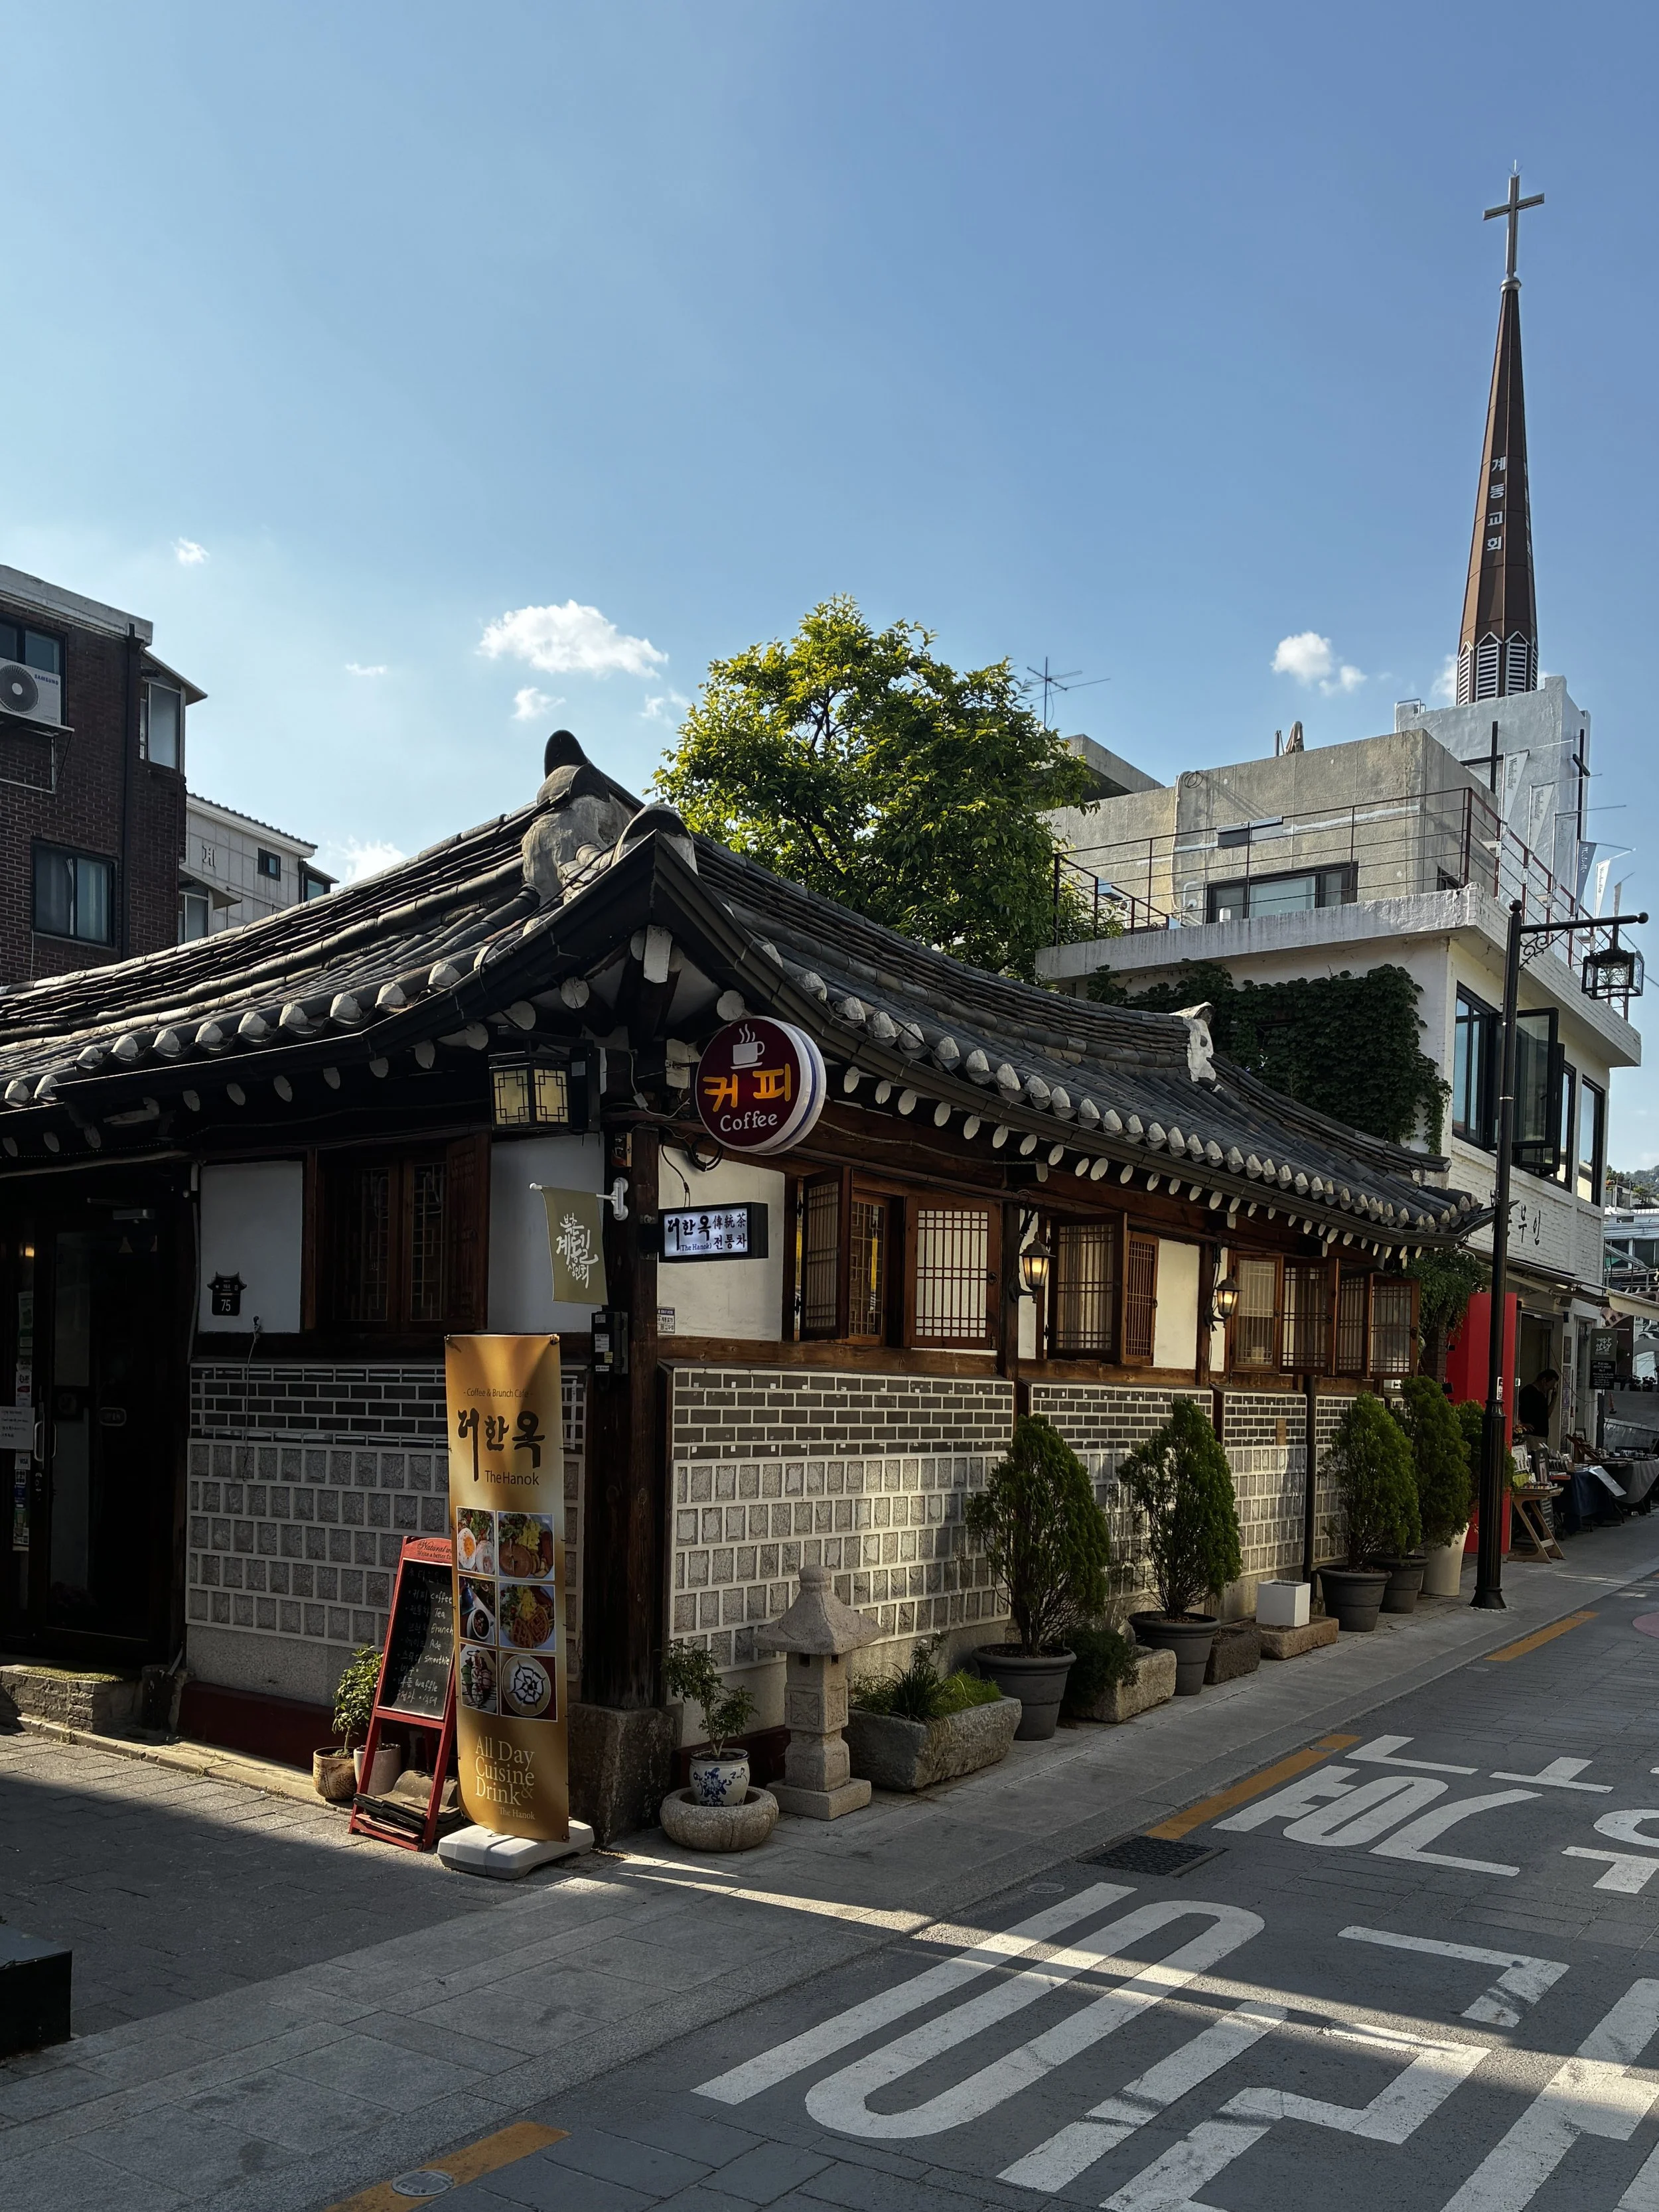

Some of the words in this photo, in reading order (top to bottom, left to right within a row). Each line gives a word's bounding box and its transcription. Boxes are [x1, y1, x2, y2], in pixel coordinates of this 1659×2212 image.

[1486, 456, 1506, 551] 계동교회
[34, 674, 59, 685] SAMSUNG
[702, 1063, 792, 1113] 커피
[720, 1110, 778, 1133] Coffee
[713, 1212, 747, 1231] 傳統茶
[668, 1215, 711, 1251] 더한옥
[713, 1233, 748, 1251] 전통차
[221, 1299, 232, 1312] 75
[467, 1387, 486, 1397] Coffee
[486, 1389, 492, 1397] &
[492, 1388, 514, 1398] Brunch
[457, 1407, 546, 1482] 더한옥
[417, 1539, 447, 1553] Natural
[435, 1608, 447, 1620] Tea
[430, 1639, 443, 1651] Ade
[475, 1735, 494, 1759] All
[498, 1740, 536, 1772] Day
[475, 1756, 535, 1787] Cuisine
[520, 1782, 534, 1800] &
[475, 1775, 522, 1806] Drink
[498, 1807, 510, 1817] The
[512, 1809, 536, 1821] Hanok
